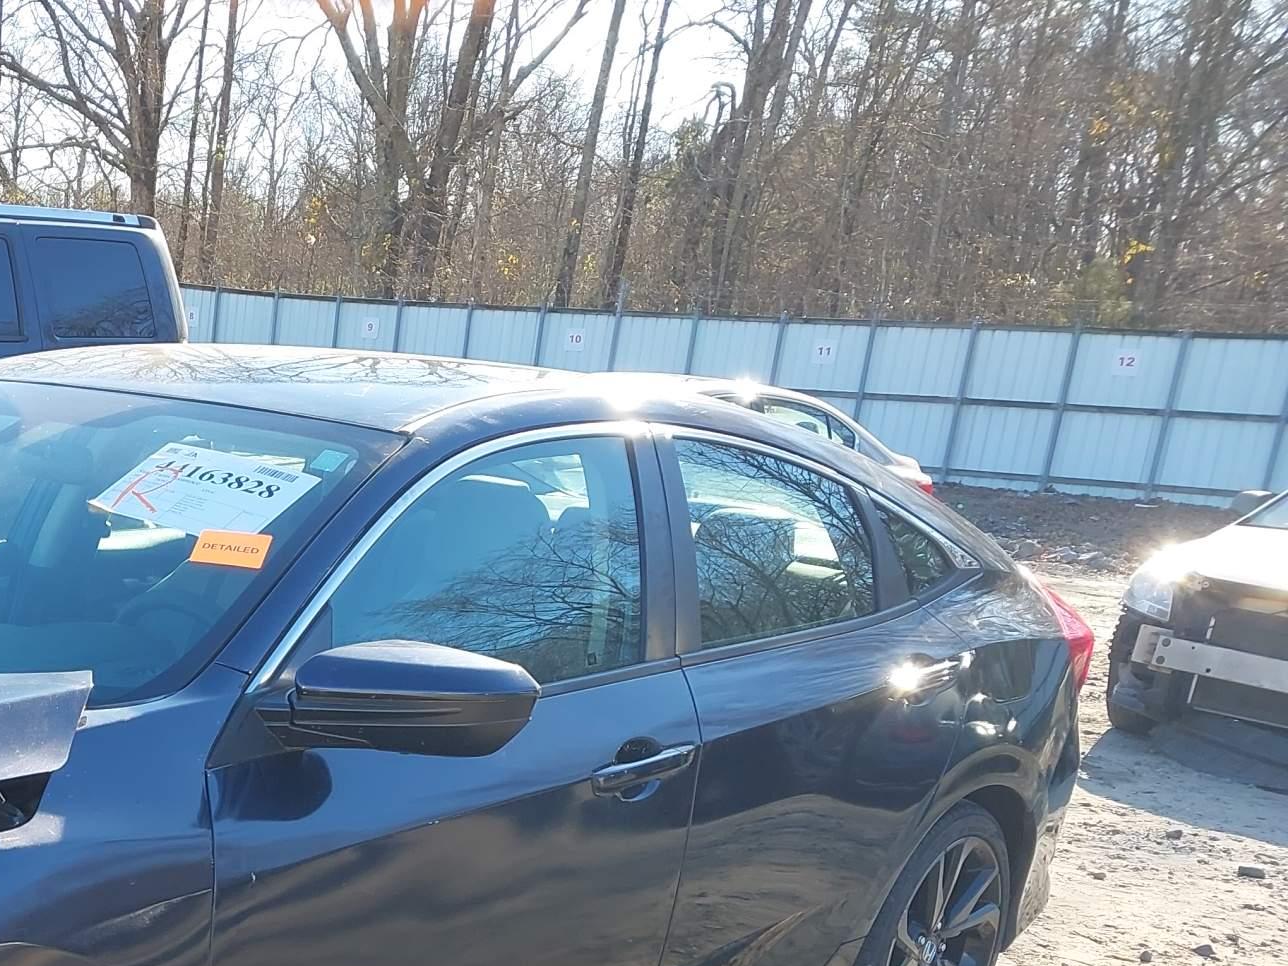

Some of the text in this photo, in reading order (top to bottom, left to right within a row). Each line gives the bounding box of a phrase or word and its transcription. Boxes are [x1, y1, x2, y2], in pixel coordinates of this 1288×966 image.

[367, 322, 374, 332] 9
[569, 334, 582, 344] 10
[817, 346, 832, 356] 11
[1118, 356, 1136, 367] 12
[155, 460, 281, 499] 44163828
[201, 541, 260, 555] DETAILED
